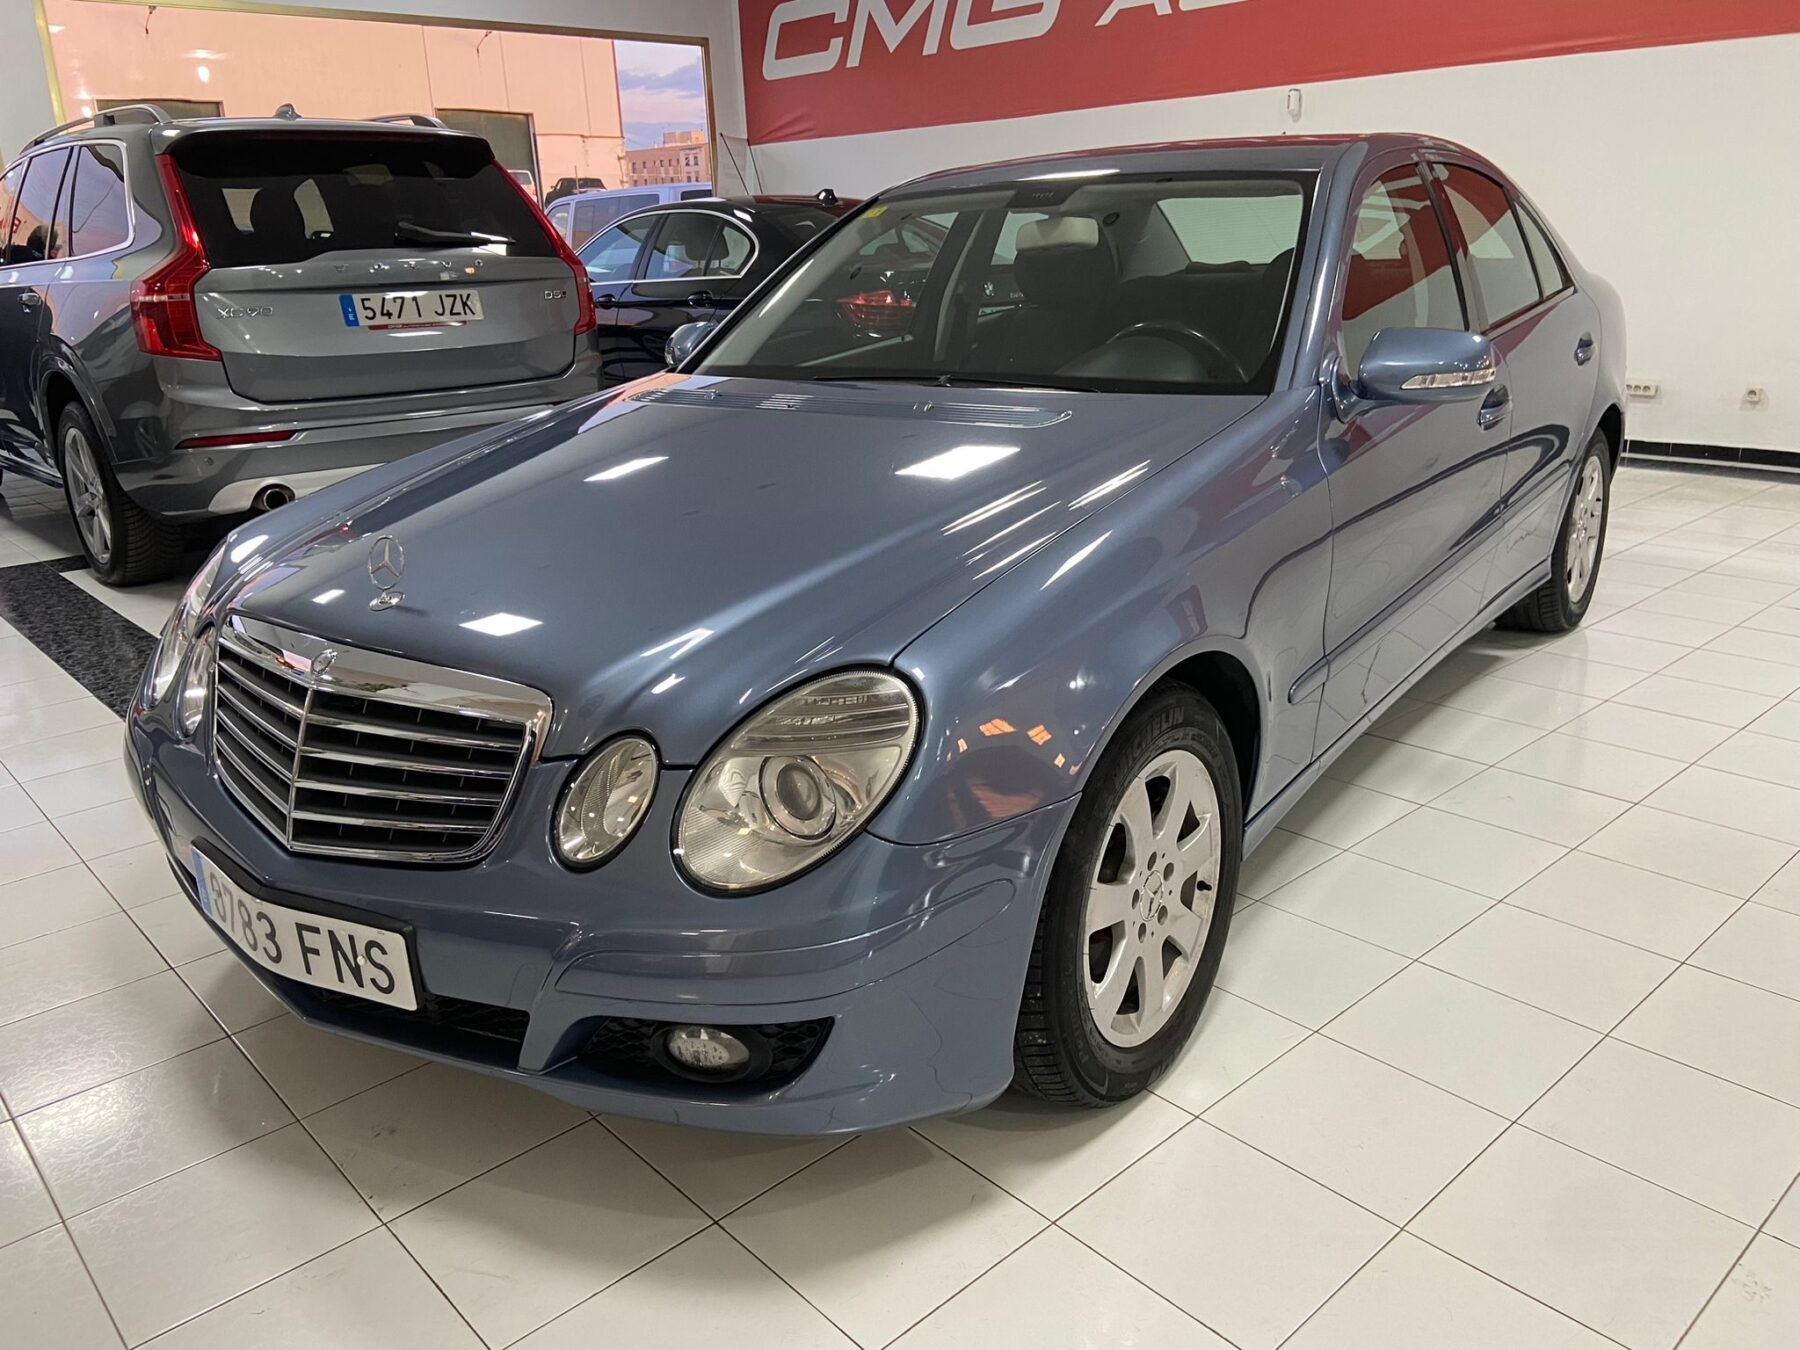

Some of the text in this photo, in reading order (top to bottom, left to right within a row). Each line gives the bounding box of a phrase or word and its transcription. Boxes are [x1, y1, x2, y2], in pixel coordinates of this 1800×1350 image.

[762, 0, 1062, 81] CMG
[360, 296, 422, 320] 5471
[434, 293, 476, 316] JZK
[210, 871, 396, 995] 8783 FNS
